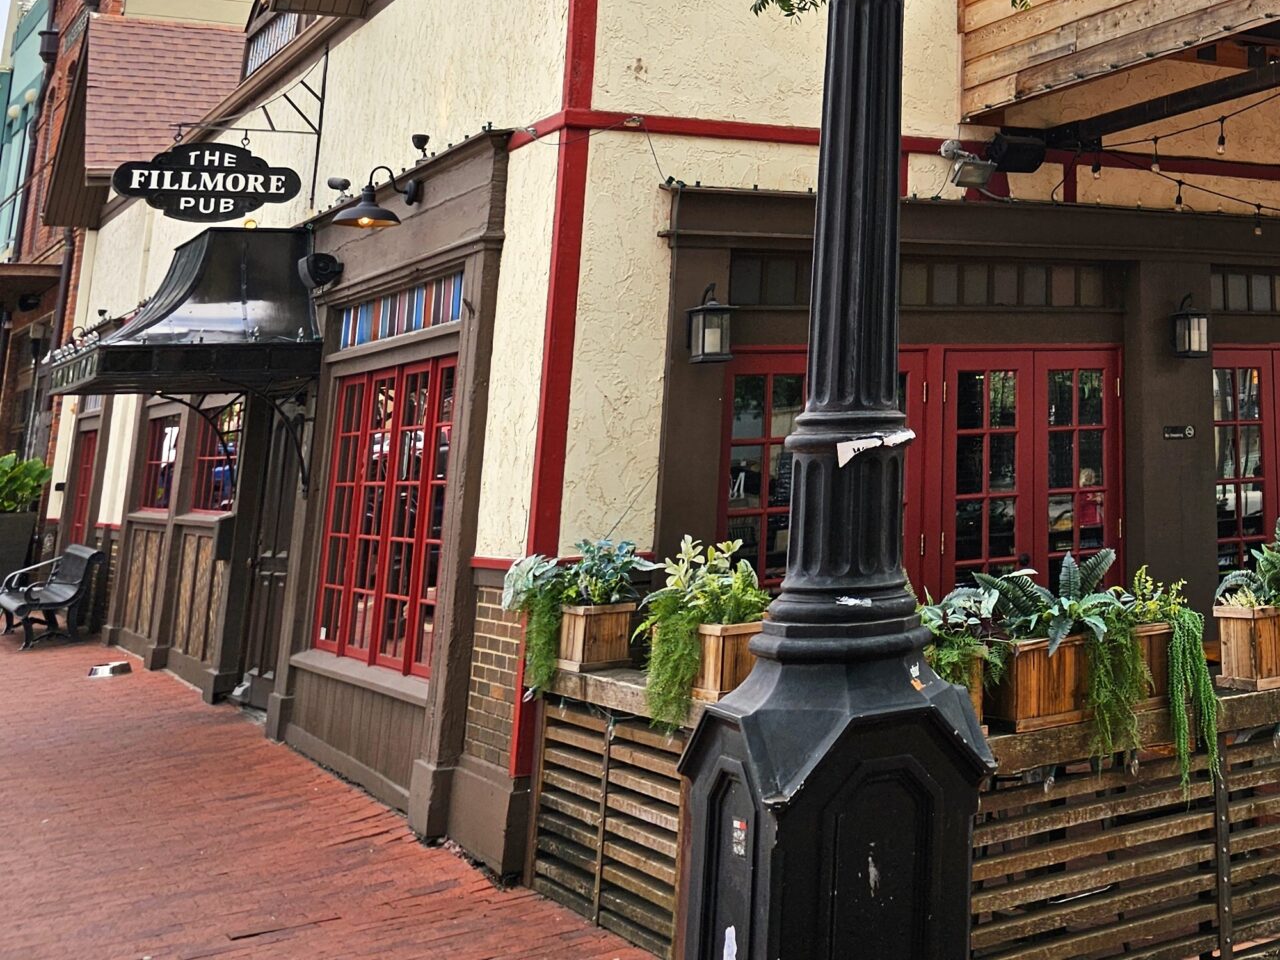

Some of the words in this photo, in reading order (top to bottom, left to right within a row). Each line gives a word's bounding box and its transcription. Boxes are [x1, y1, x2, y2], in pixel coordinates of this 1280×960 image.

[188, 150, 237, 167] THE
[129, 169, 286, 194] FILLMORE
[179, 197, 234, 214] PUB
